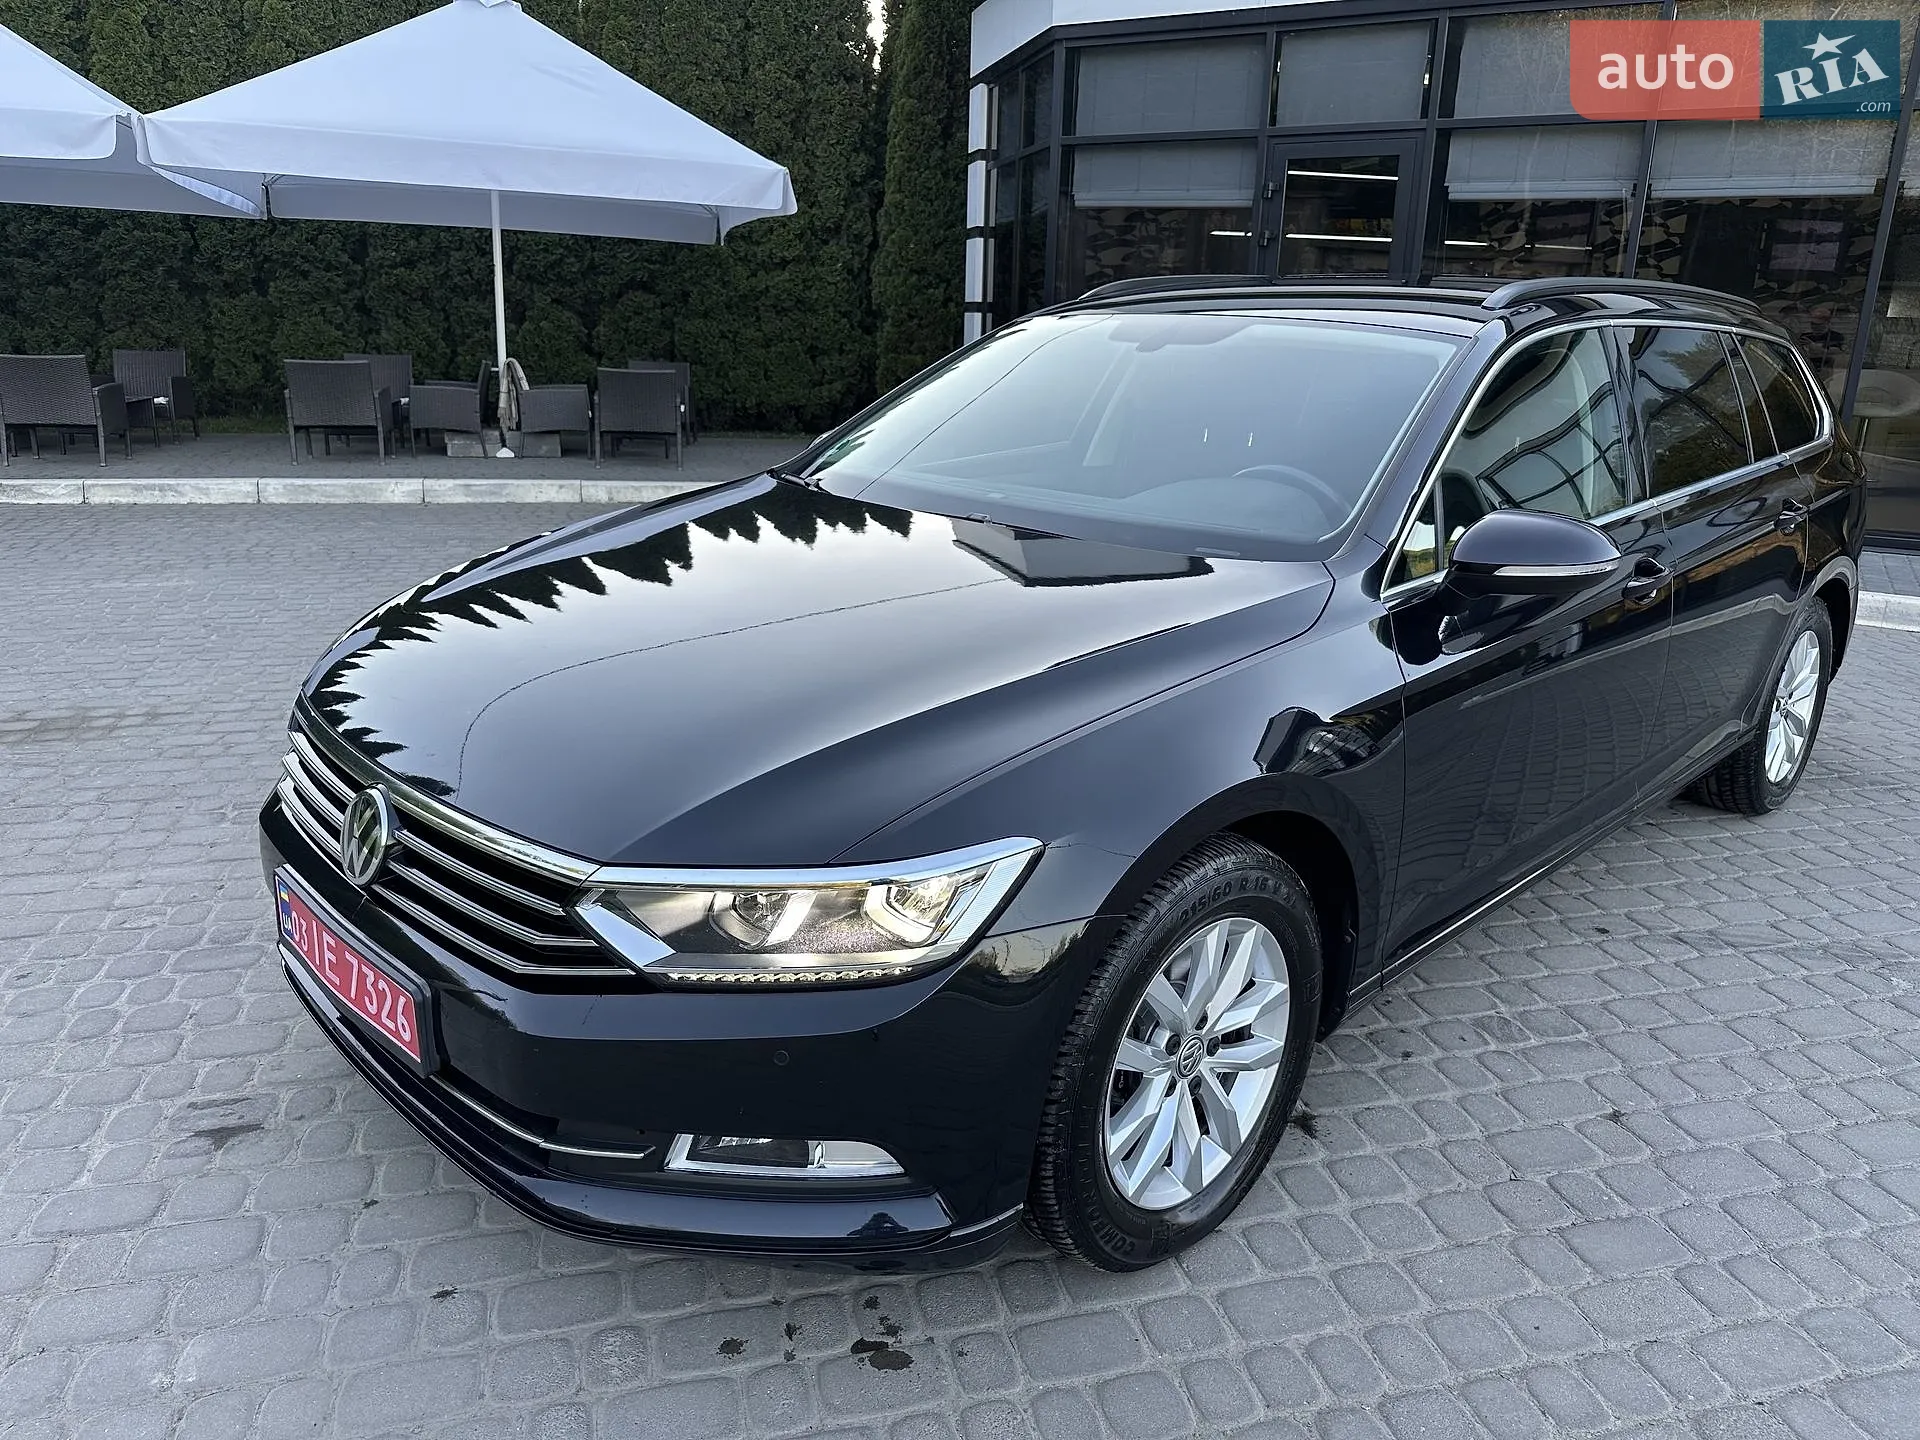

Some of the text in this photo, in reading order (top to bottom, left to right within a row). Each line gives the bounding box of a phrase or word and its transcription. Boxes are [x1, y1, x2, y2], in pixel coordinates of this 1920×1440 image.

[283, 911, 293, 934] UA
[291, 910, 411, 1043] 03 IE 7326
